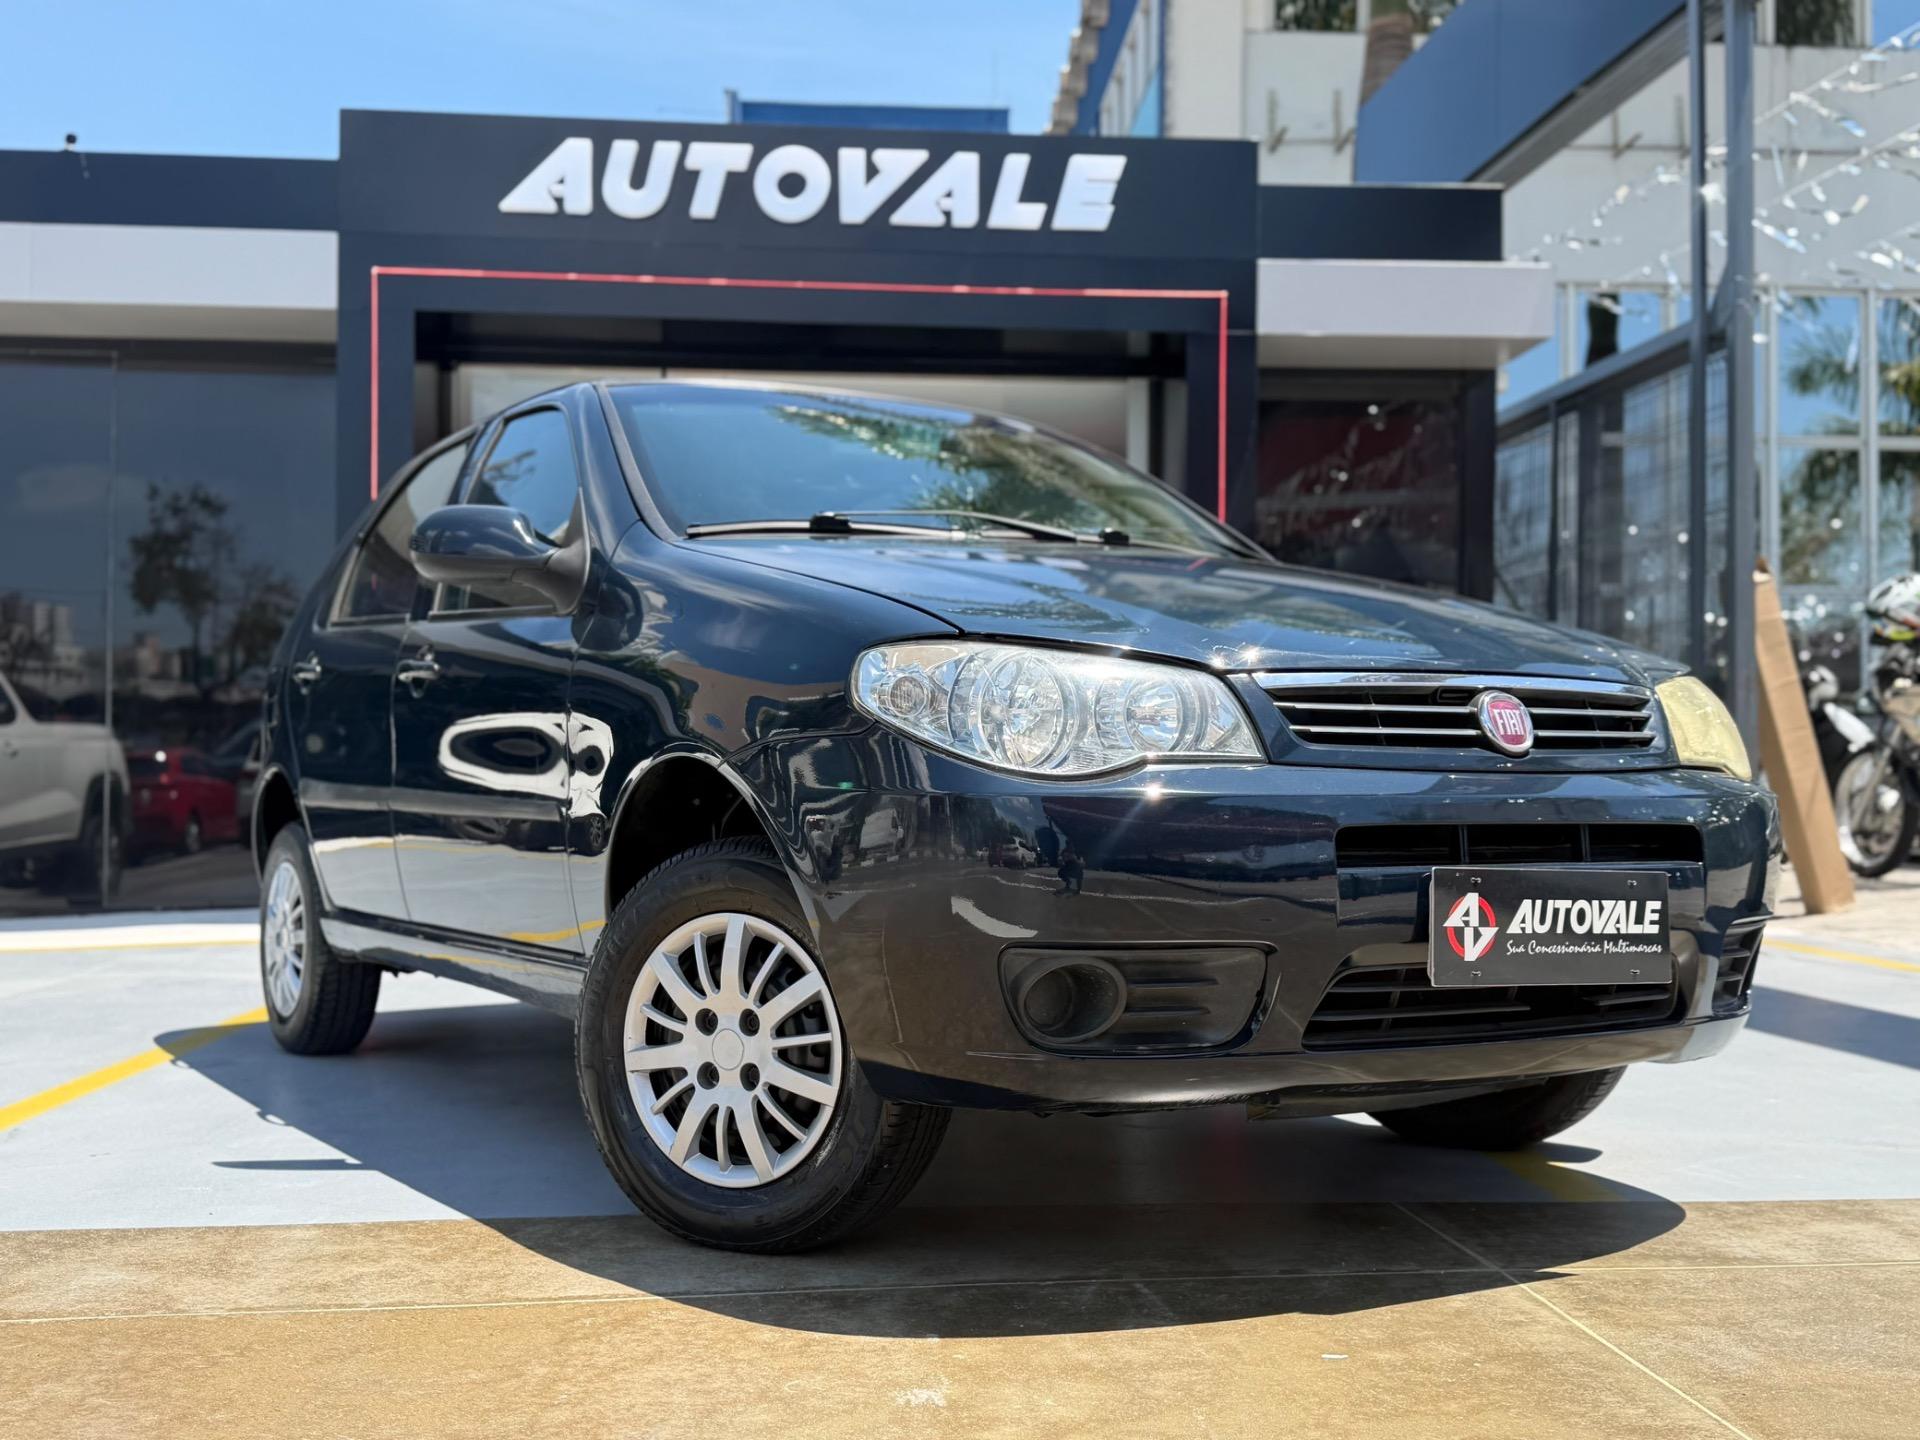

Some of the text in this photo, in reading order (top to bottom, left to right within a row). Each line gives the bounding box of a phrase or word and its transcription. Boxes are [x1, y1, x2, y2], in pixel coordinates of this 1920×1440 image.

[498, 137, 1127, 231] AUTOVALE
[1493, 708, 1524, 736] FIAT
[1506, 899, 1662, 934] AUTOVALE
[1506, 939, 1662, 956] Sua Concessionária Multimarcas
